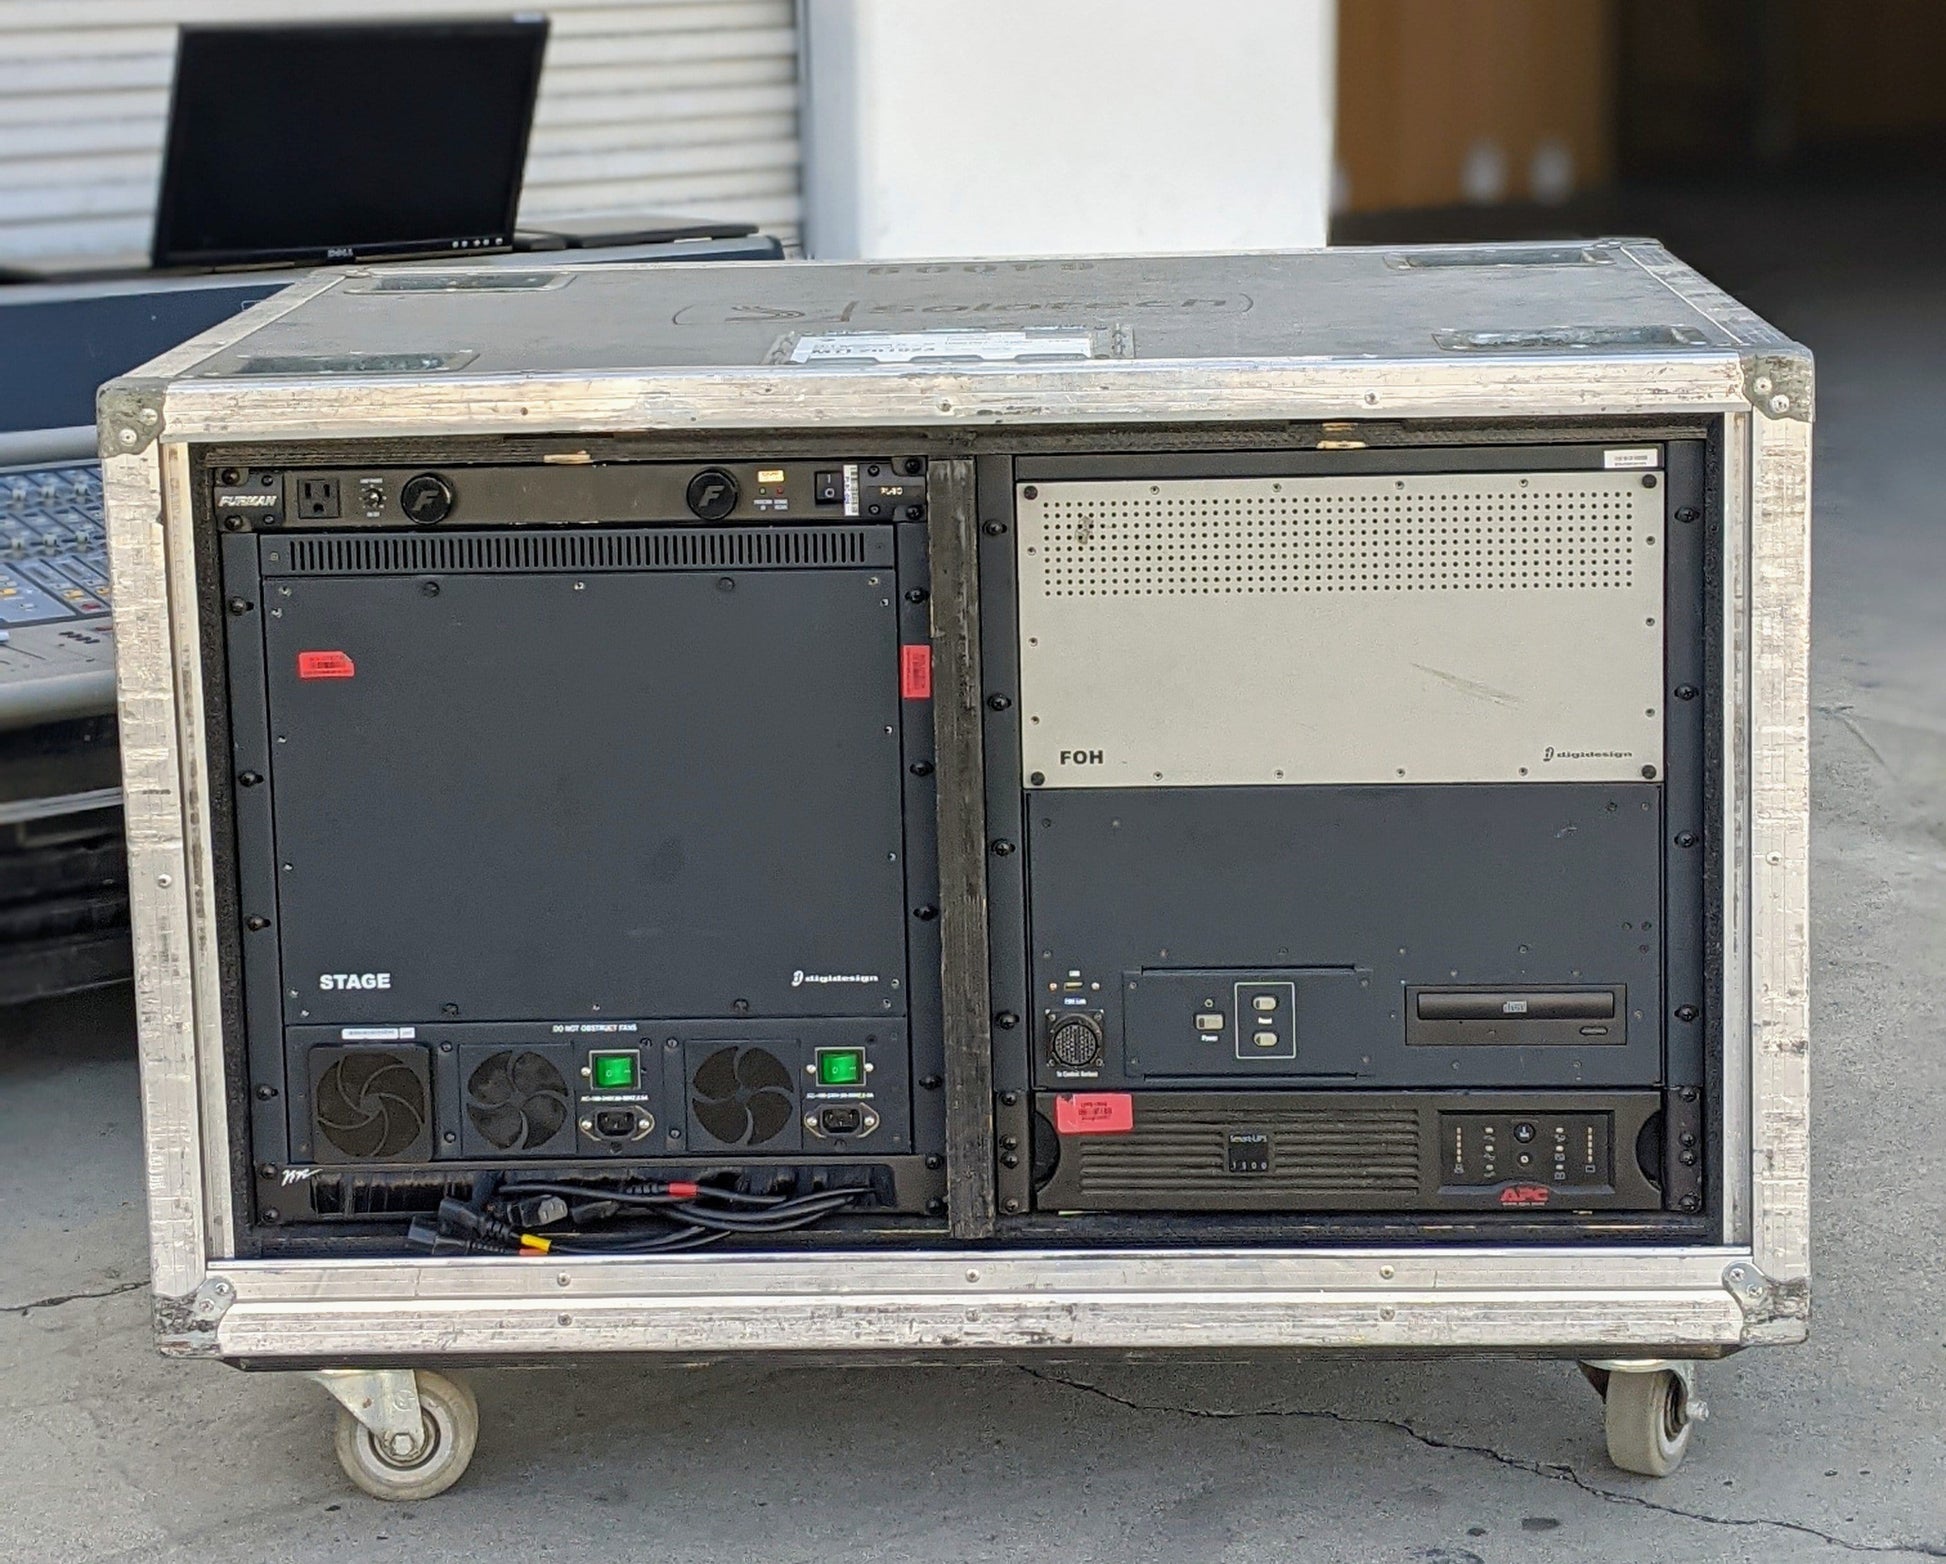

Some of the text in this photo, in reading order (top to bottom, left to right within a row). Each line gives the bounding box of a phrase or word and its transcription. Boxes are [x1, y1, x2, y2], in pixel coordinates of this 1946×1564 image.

[219, 495, 277, 507] FURMAN
[1060, 750, 1104, 765] FOH
[1556, 751, 1633, 760] digidesign
[320, 973, 391, 990] STAGE
[804, 973, 879, 984] digidesign
[552, 1023, 637, 1033] DO NOT OBSTRUCT FANS
[1500, 1187, 1549, 1201] APC
